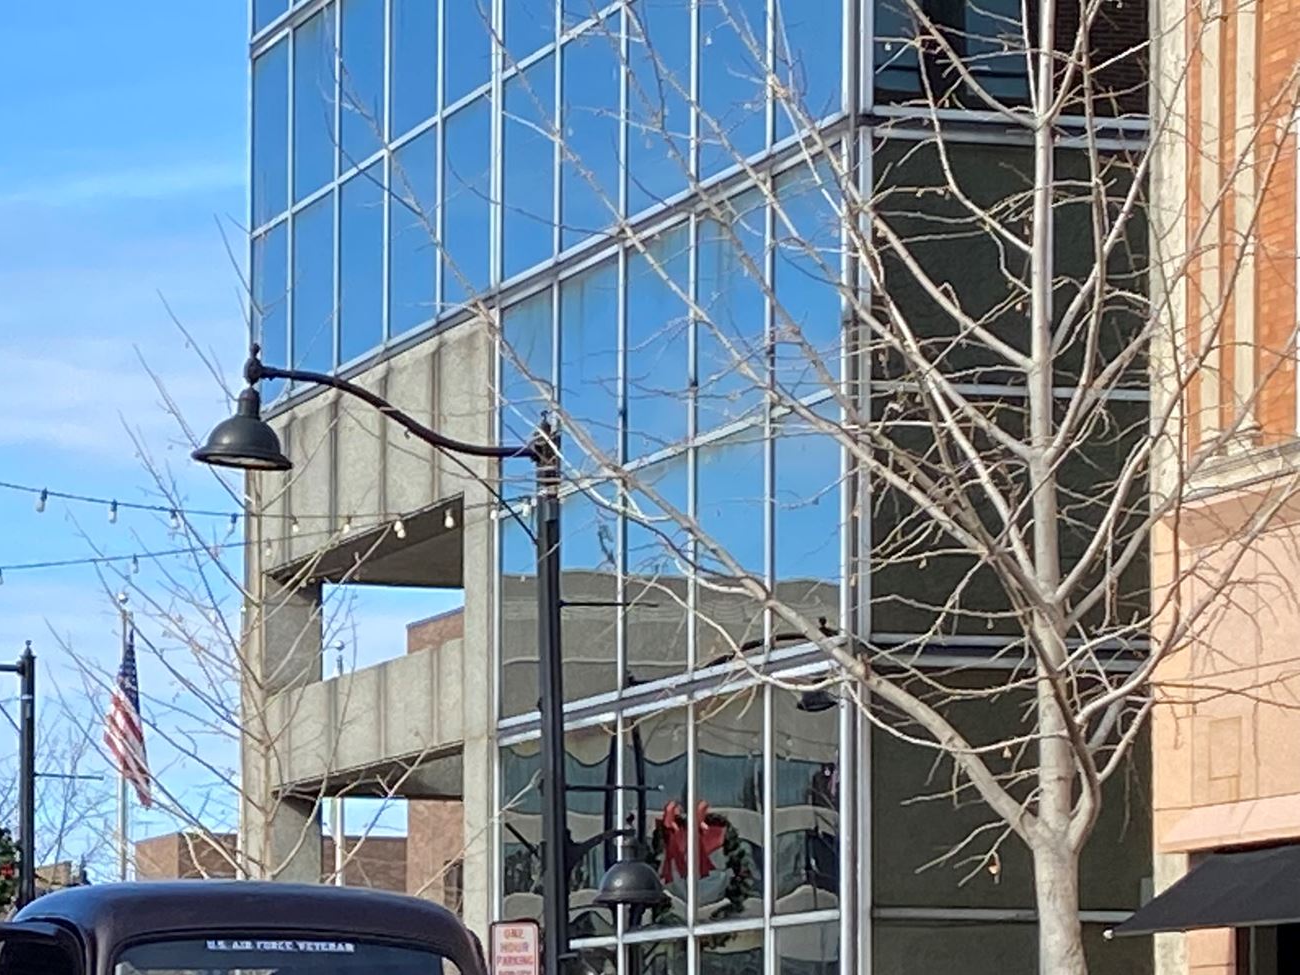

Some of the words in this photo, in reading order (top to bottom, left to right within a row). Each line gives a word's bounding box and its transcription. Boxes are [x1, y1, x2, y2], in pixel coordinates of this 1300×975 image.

[232, 940, 253, 950] AIR
[256, 940, 293, 951] FORCE
[295, 941, 355, 952] VETERAN
[500, 942, 529, 953] HOUR
[497, 955, 533, 967] PARKING
